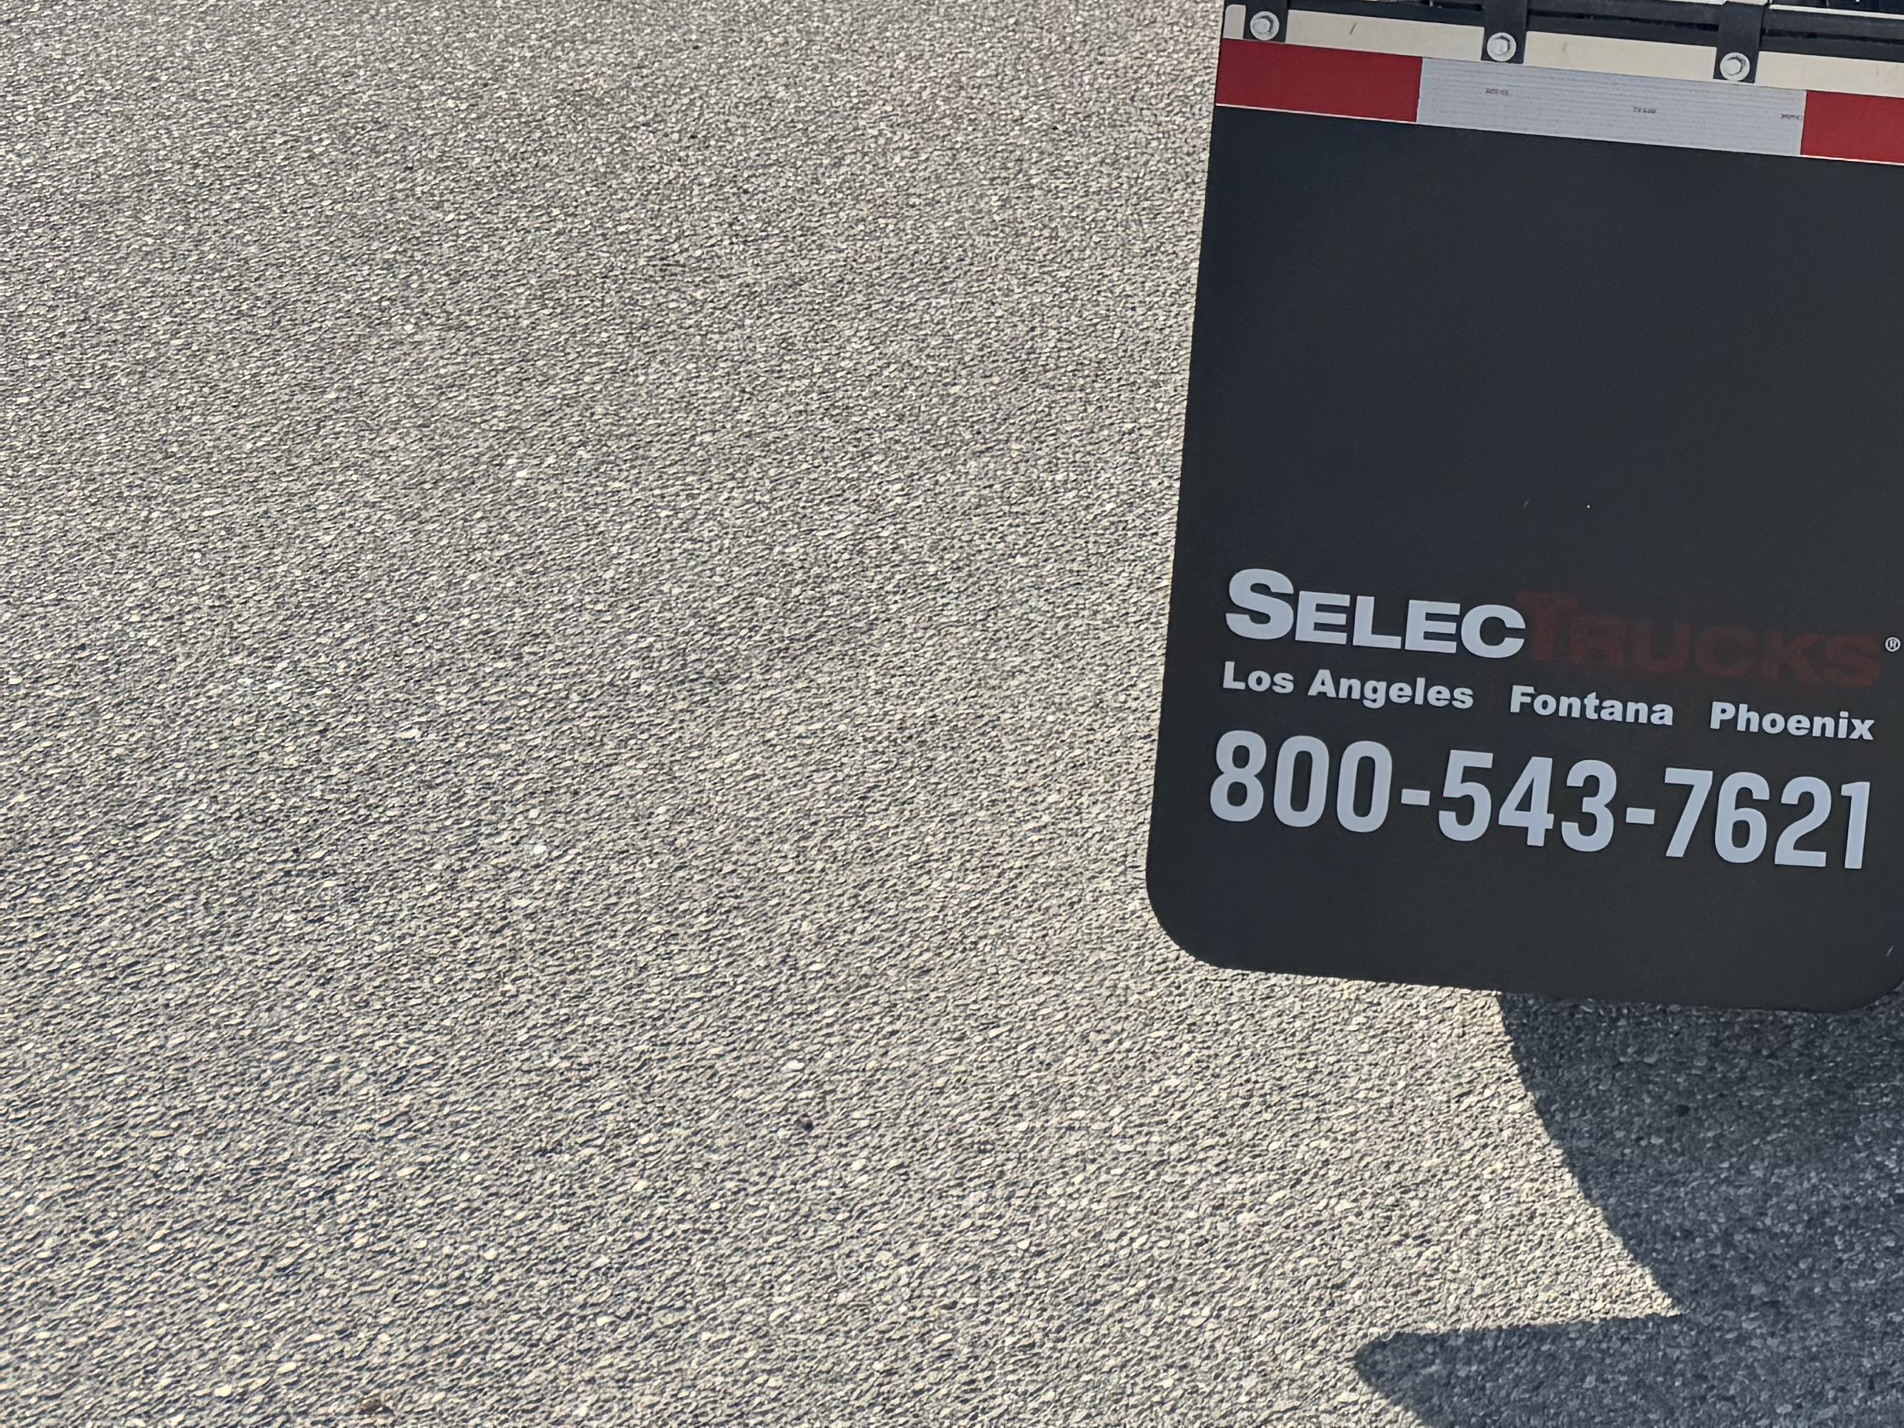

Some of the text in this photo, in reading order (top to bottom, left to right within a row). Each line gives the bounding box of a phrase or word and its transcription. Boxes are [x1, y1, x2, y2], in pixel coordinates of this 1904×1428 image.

[1222, 661, 1875, 741] Los Angeles Fontana Phoenix
[1210, 730, 1874, 870] 800-543-7621
